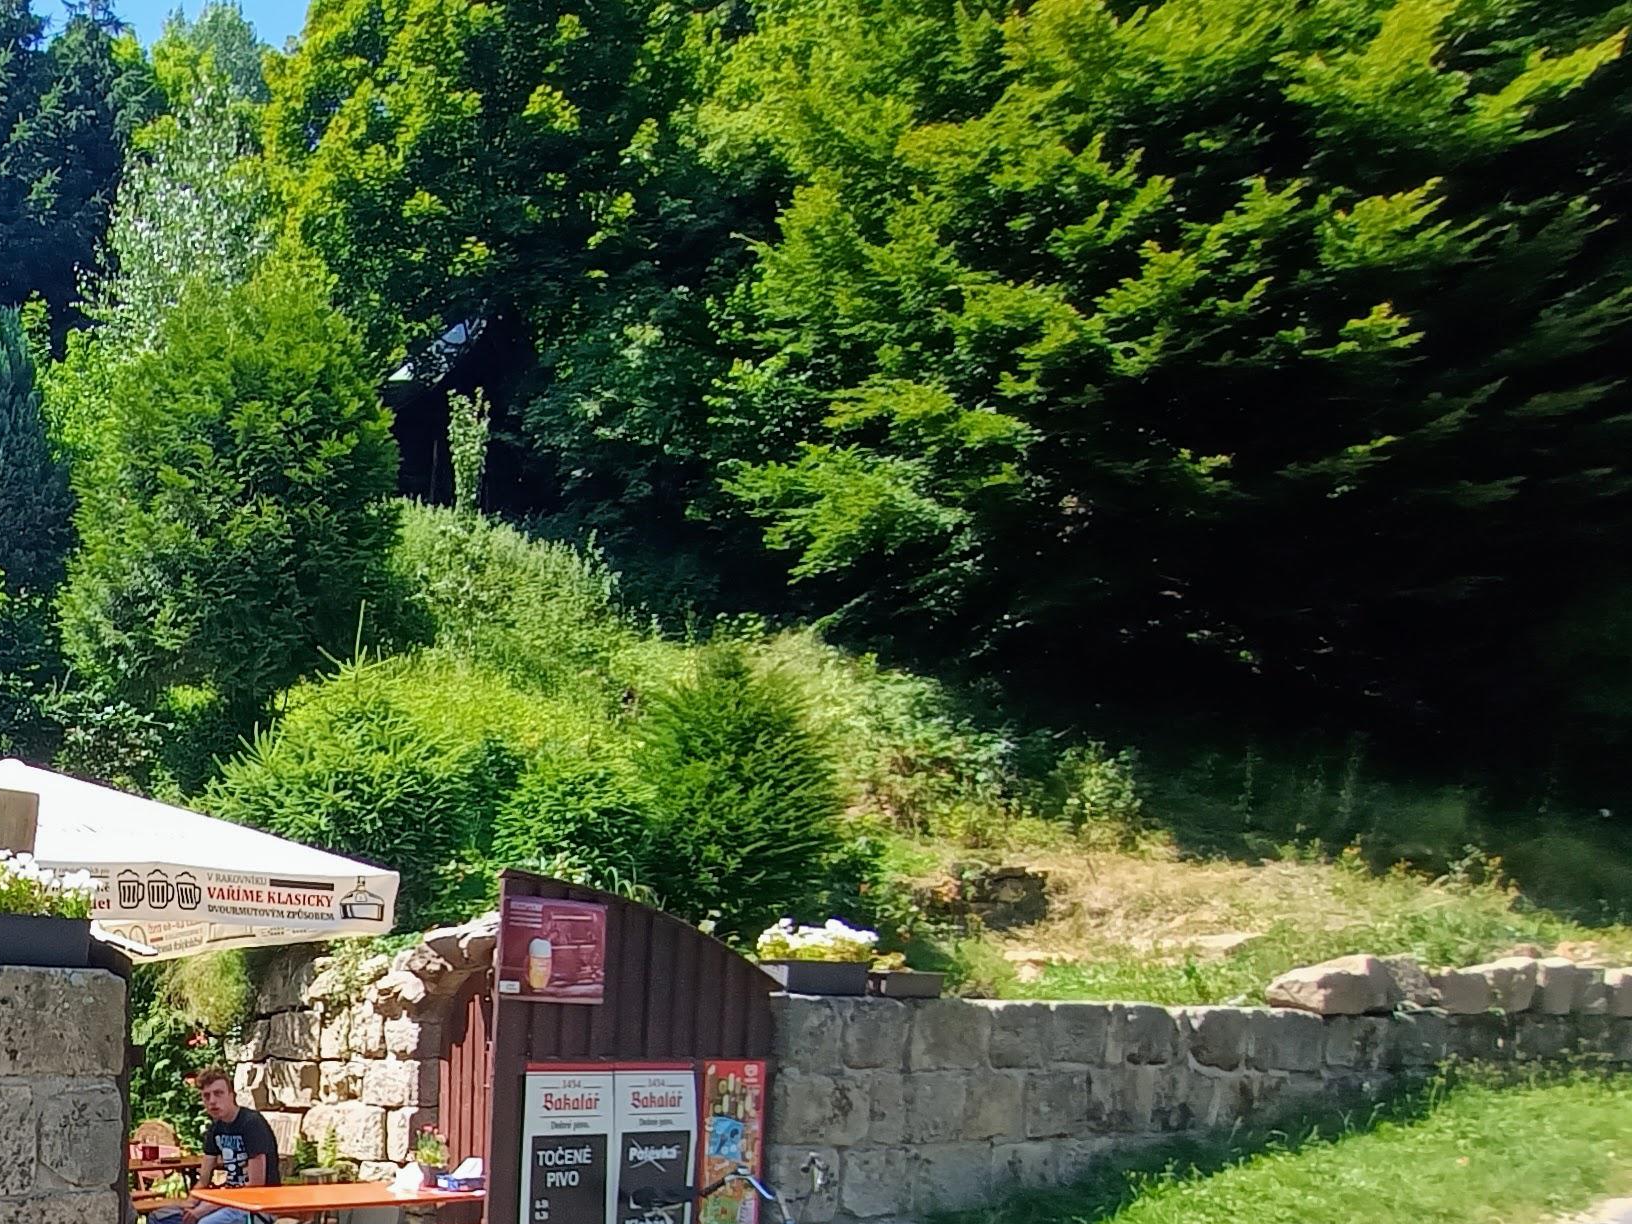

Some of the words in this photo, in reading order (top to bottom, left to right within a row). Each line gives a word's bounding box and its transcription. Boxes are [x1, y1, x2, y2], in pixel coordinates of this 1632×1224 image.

[207, 872, 214, 881] V
[207, 886, 264, 903] VAŘÍME
[267, 891, 334, 908] KLASICKY
[286, 908, 335, 921] ZPŮSOBEM
[536, 1145, 593, 1167] TOČENÉ
[546, 1170, 580, 1188] PIVO
